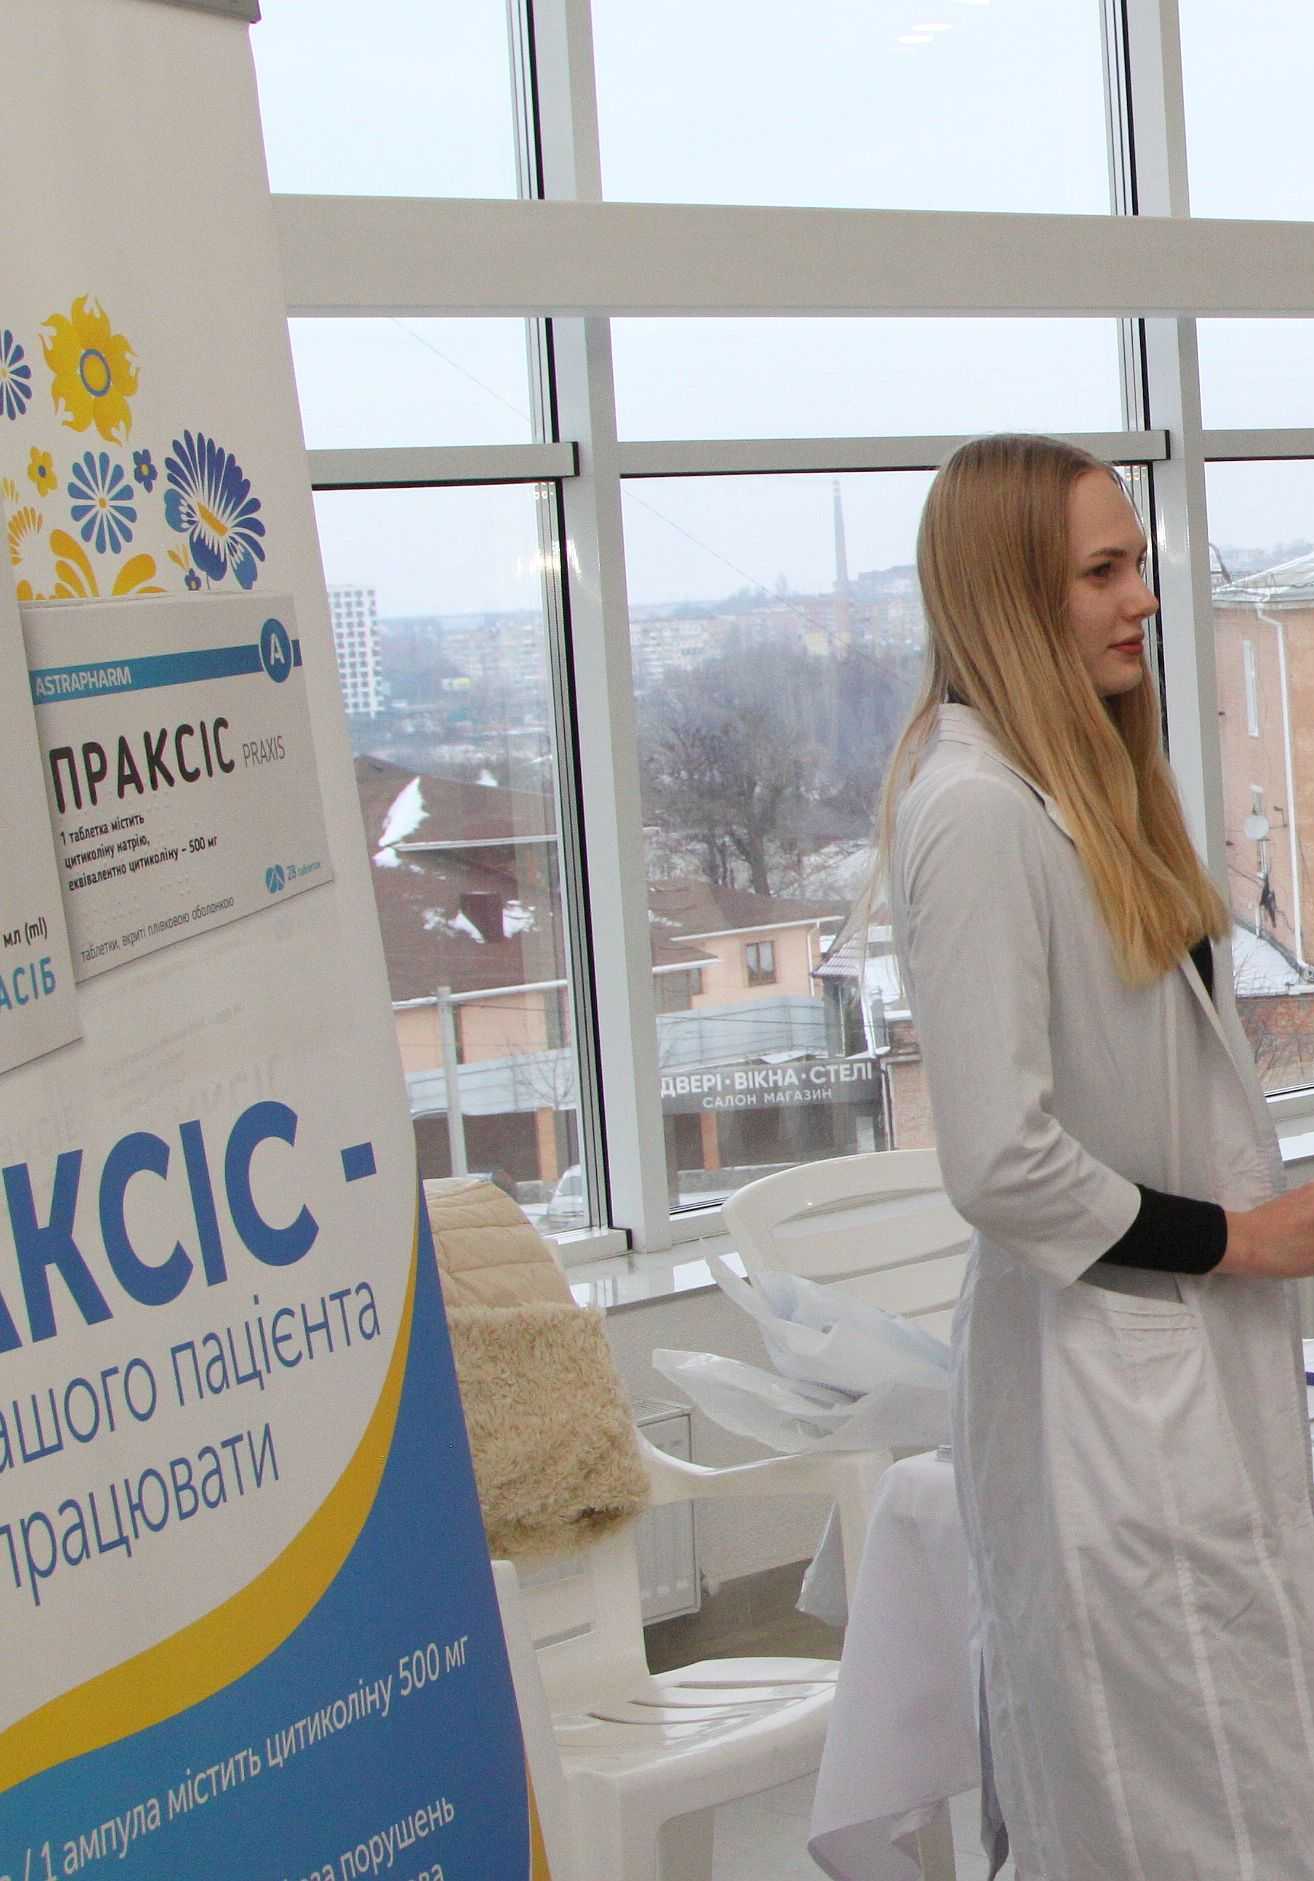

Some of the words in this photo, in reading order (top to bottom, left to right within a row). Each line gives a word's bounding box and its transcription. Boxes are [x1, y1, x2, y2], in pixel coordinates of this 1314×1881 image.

[36, 666, 132, 697] ASTRAPHARM
[49, 716, 236, 814] ПРАКСІС
[241, 735, 286, 769] PRAXIS
[61, 831, 67, 846] 1
[69, 823, 109, 843] таблетка
[111, 813, 145, 833] містить
[64, 843, 115, 870] цитиколіну
[117, 834, 150, 854] натрію,
[68, 864, 127, 892] еквівалентно
[128, 846, 179, 872] цитиколіну
[188, 836, 206, 854] 500
[207, 835, 218, 848] мг
[3, 929, 21, 948] мл
[25, 916, 48, 945] (ml)
[660, 1072, 722, 1098] ДВЕРІ
[734, 1068, 799, 1090] ВІКНА
[810, 1062, 872, 1084] СТЕЛІ
[703, 1094, 757, 1109] САЛОН
[764, 1088, 832, 1104] МАГАЗИН
[0, 1100, 319, 1354] КСІС
[171, 1280, 381, 1407] пацієнта
[64, 1797, 161, 1875] ампула
[167, 1748, 261, 1822] містить
[266, 1674, 392, 1769] цитиколіну
[399, 1642, 439, 1696] 500
[446, 1634, 468, 1673] мг
[339, 1796, 455, 1881] порушень
